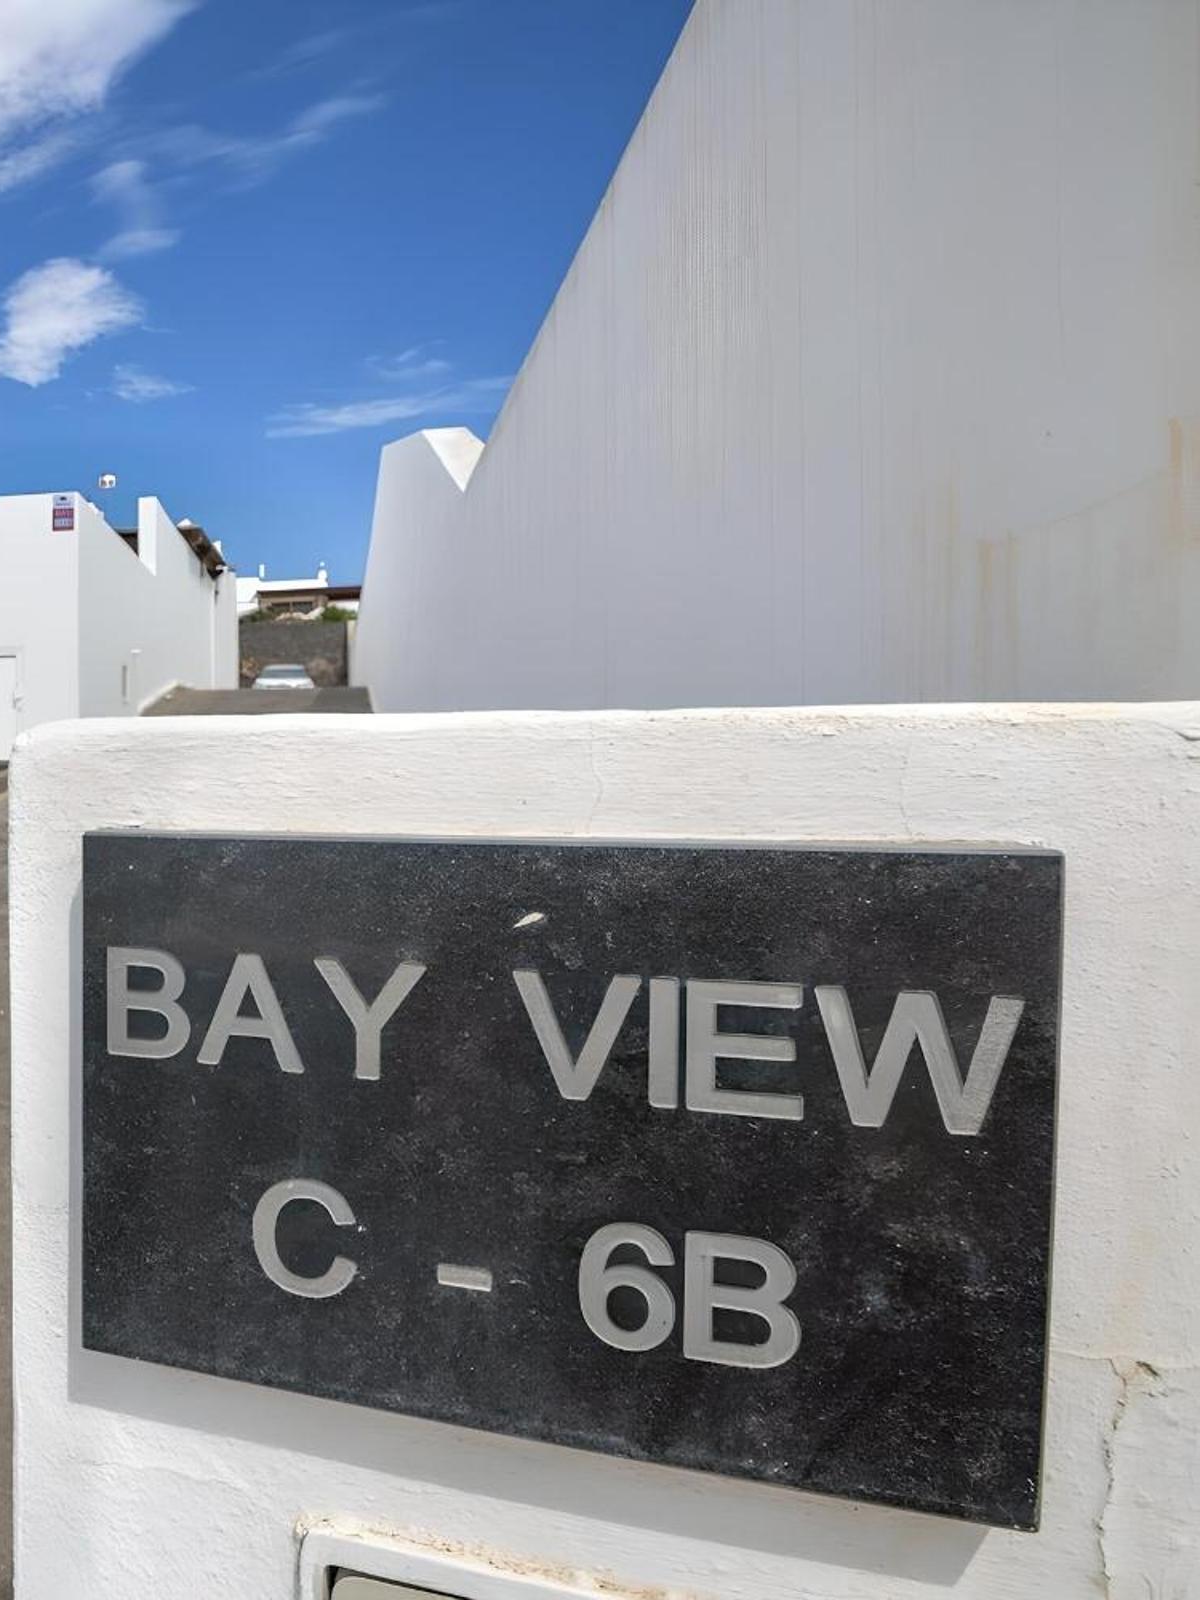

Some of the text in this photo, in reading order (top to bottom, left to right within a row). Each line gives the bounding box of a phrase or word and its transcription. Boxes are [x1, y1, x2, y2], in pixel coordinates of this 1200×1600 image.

[106, 946, 1026, 1136] BAY VIEW
[251, 1177, 359, 1299] C
[577, 1221, 801, 1370] 6B
